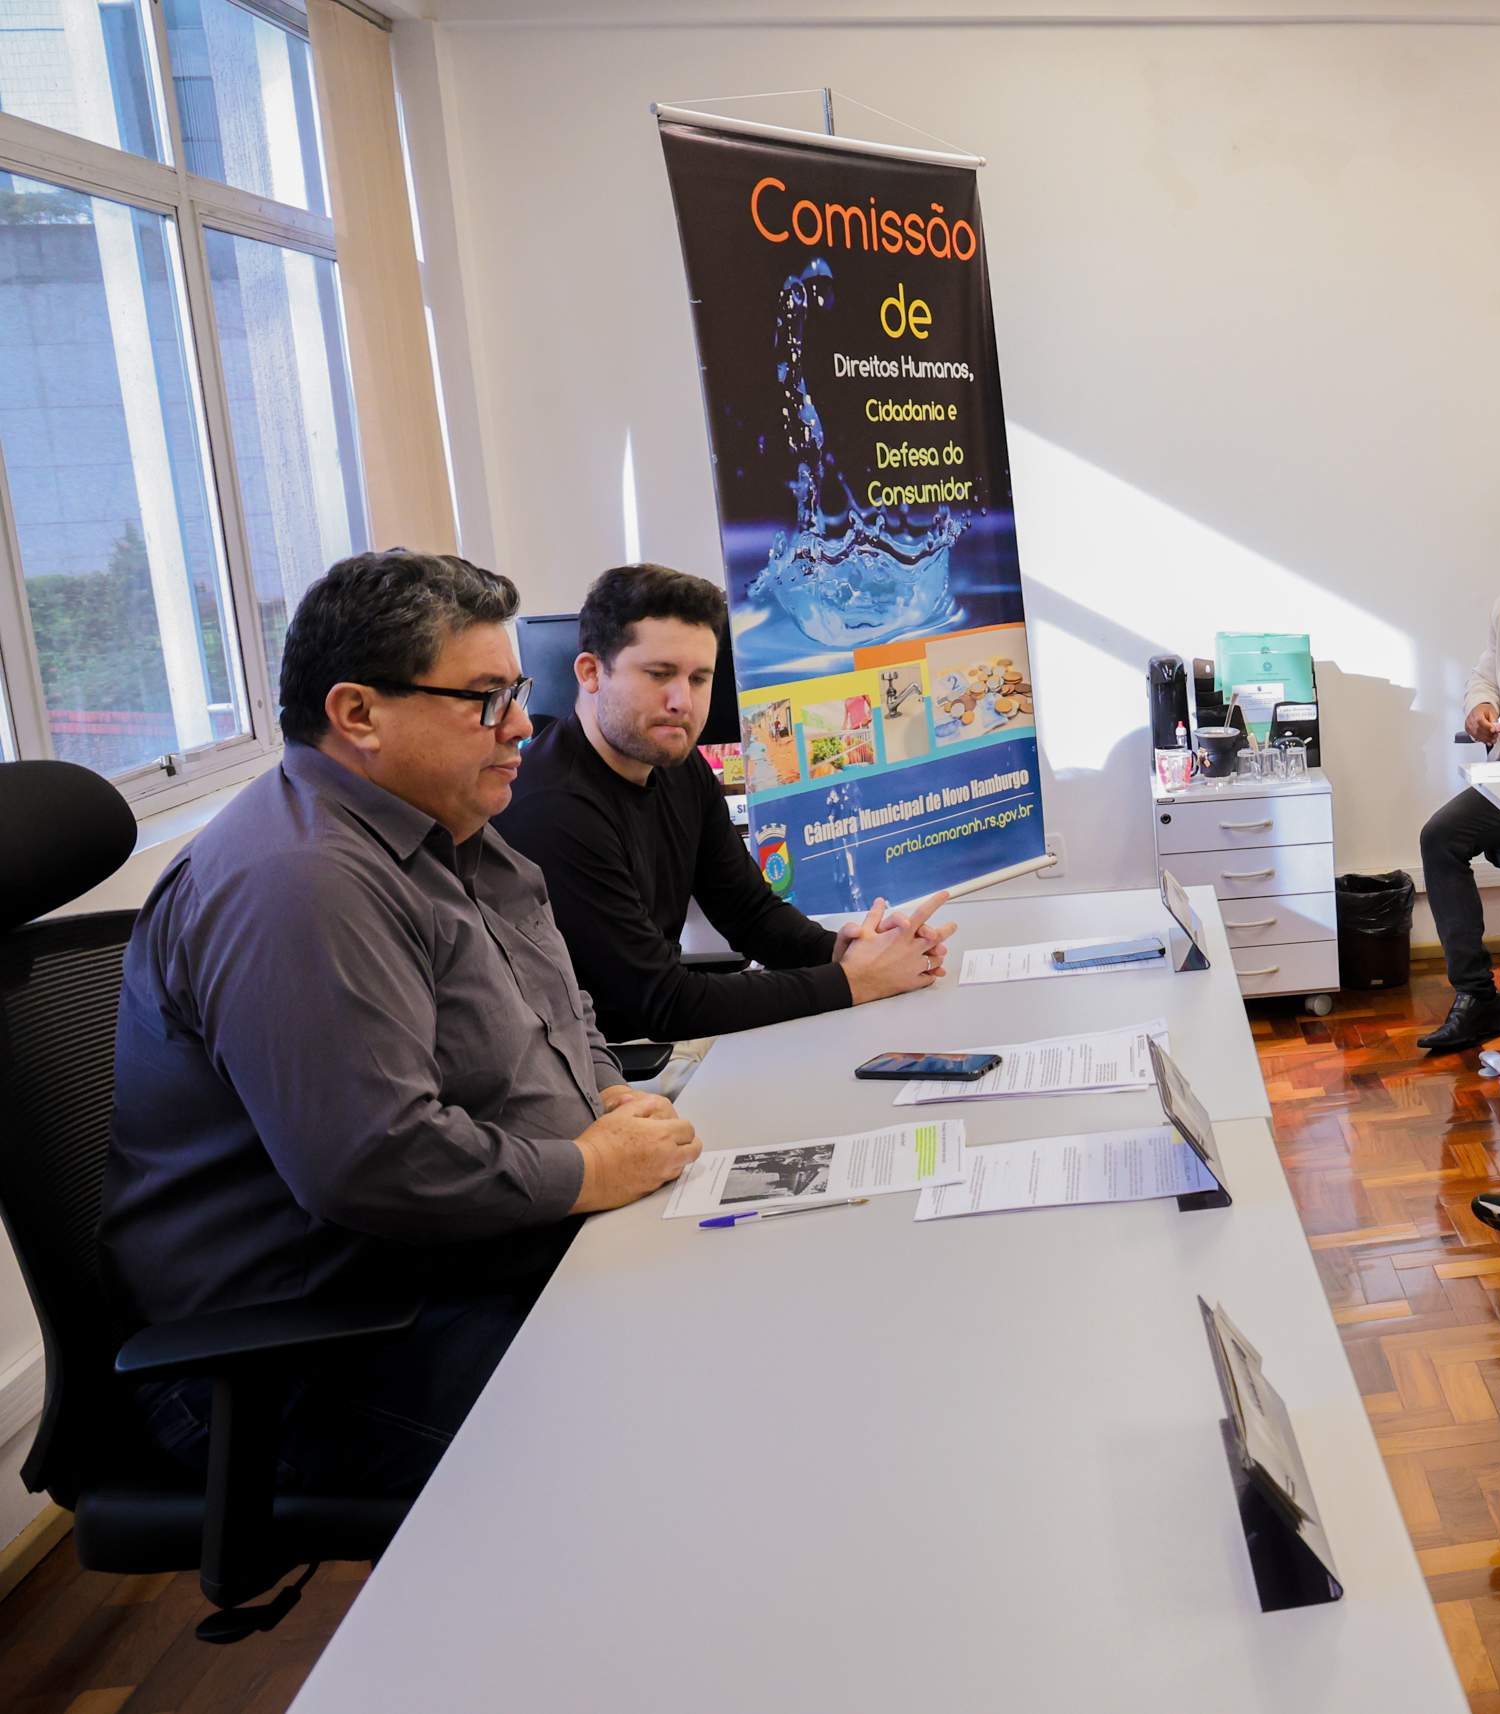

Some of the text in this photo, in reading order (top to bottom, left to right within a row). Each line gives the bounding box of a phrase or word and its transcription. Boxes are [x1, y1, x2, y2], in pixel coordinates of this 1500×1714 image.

[751, 177, 977, 261] Comissão
[880, 283, 933, 340] de
[833, 353, 975, 382] Direitos Humanos,
[865, 399, 958, 422] Cidadania e
[876, 440, 965, 469] Defesa do
[867, 476, 973, 507] Consumidor
[804, 769, 1030, 846] Câmara Municipal de Novo Hamburgo
[885, 804, 1034, 863] portal.camaranh.rs.gov.br
